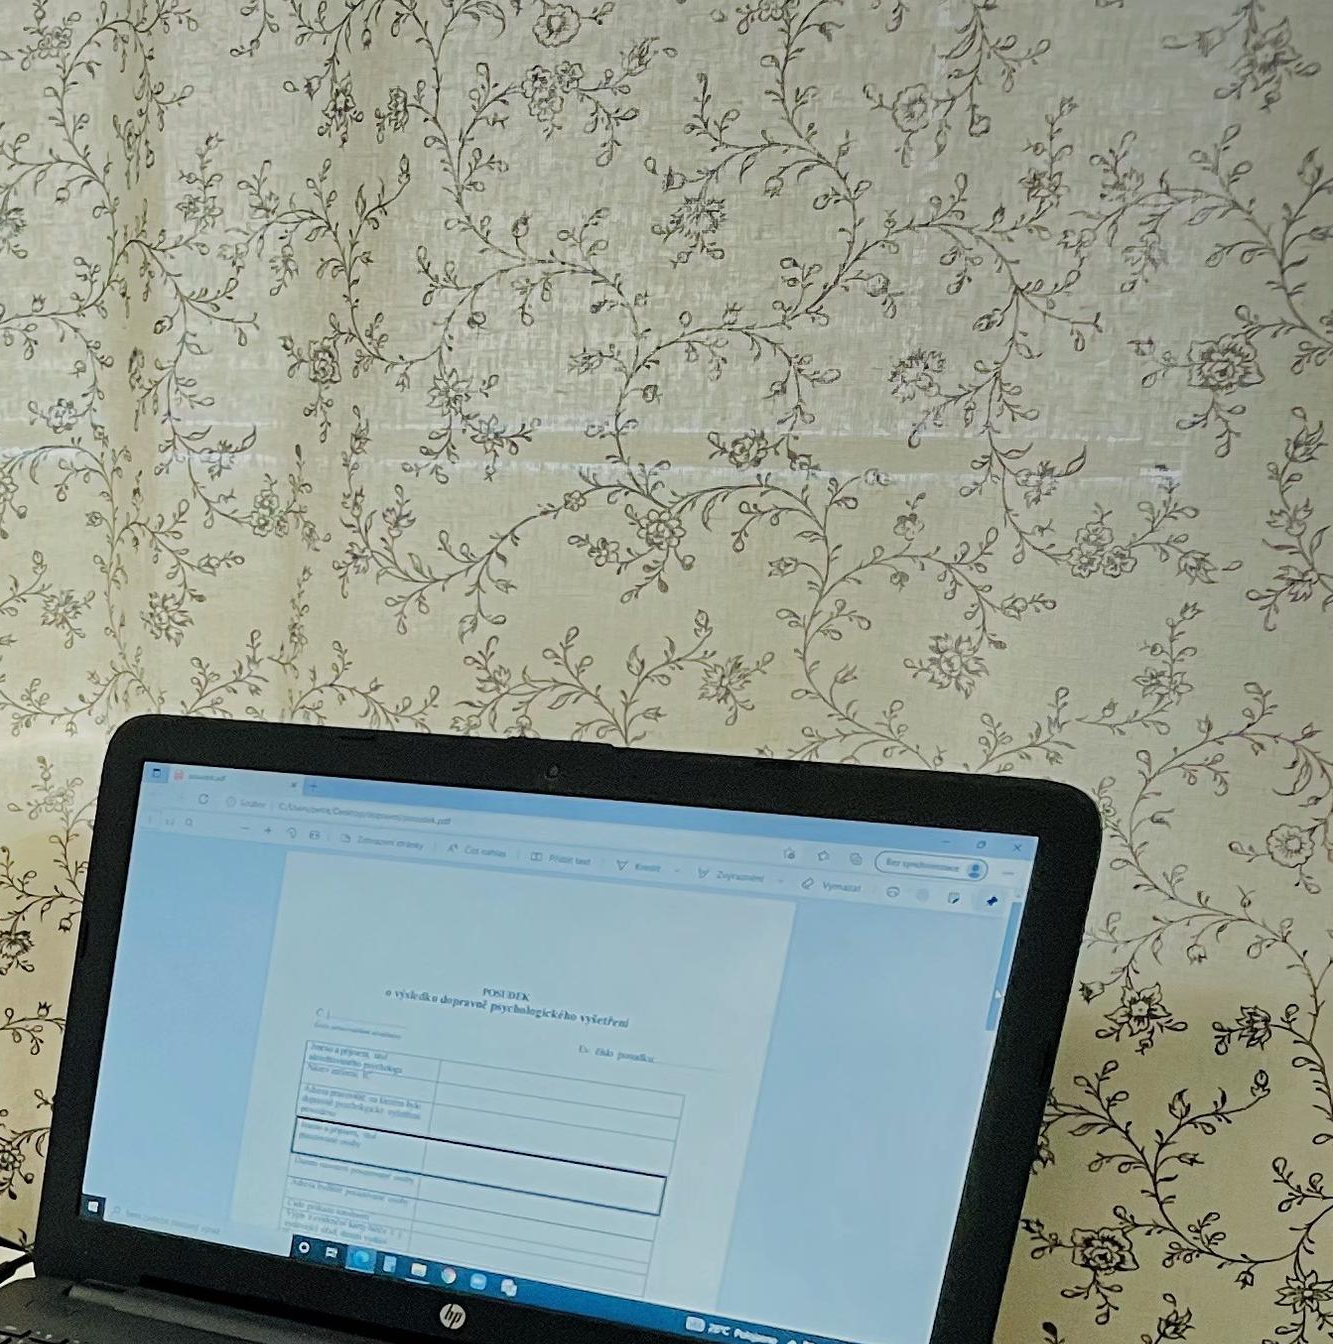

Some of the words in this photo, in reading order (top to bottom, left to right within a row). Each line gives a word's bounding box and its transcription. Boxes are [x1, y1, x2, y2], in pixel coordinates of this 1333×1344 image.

[440, 994, 487, 1010] dopravně
[489, 1001, 577, 1022] psychologického
[580, 1013, 630, 1029] vyšetření
